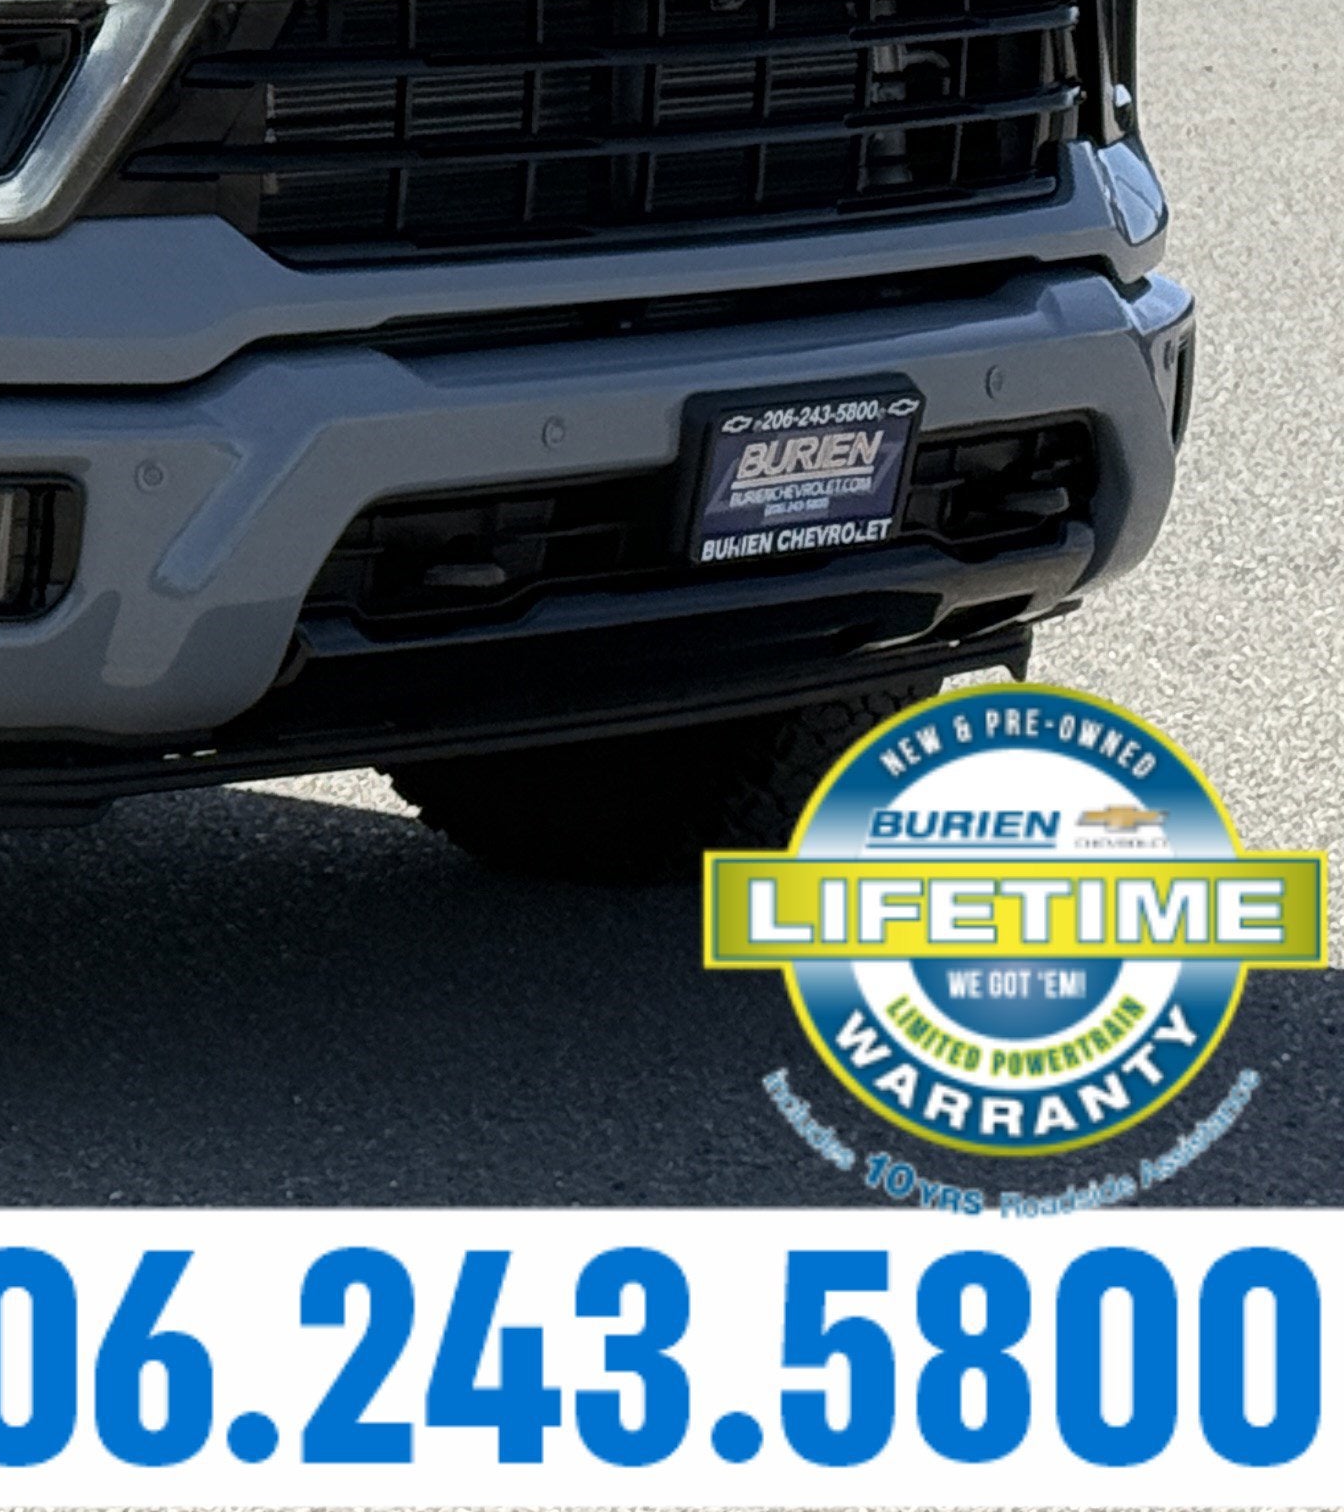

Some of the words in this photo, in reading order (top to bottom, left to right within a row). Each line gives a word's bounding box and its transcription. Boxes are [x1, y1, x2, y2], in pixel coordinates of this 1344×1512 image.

[762, 399, 879, 430] 206-243-5800
[736, 430, 885, 480] BURIEN
[700, 531, 773, 562] BURIEN
[777, 517, 893, 552] CHEVROLET
